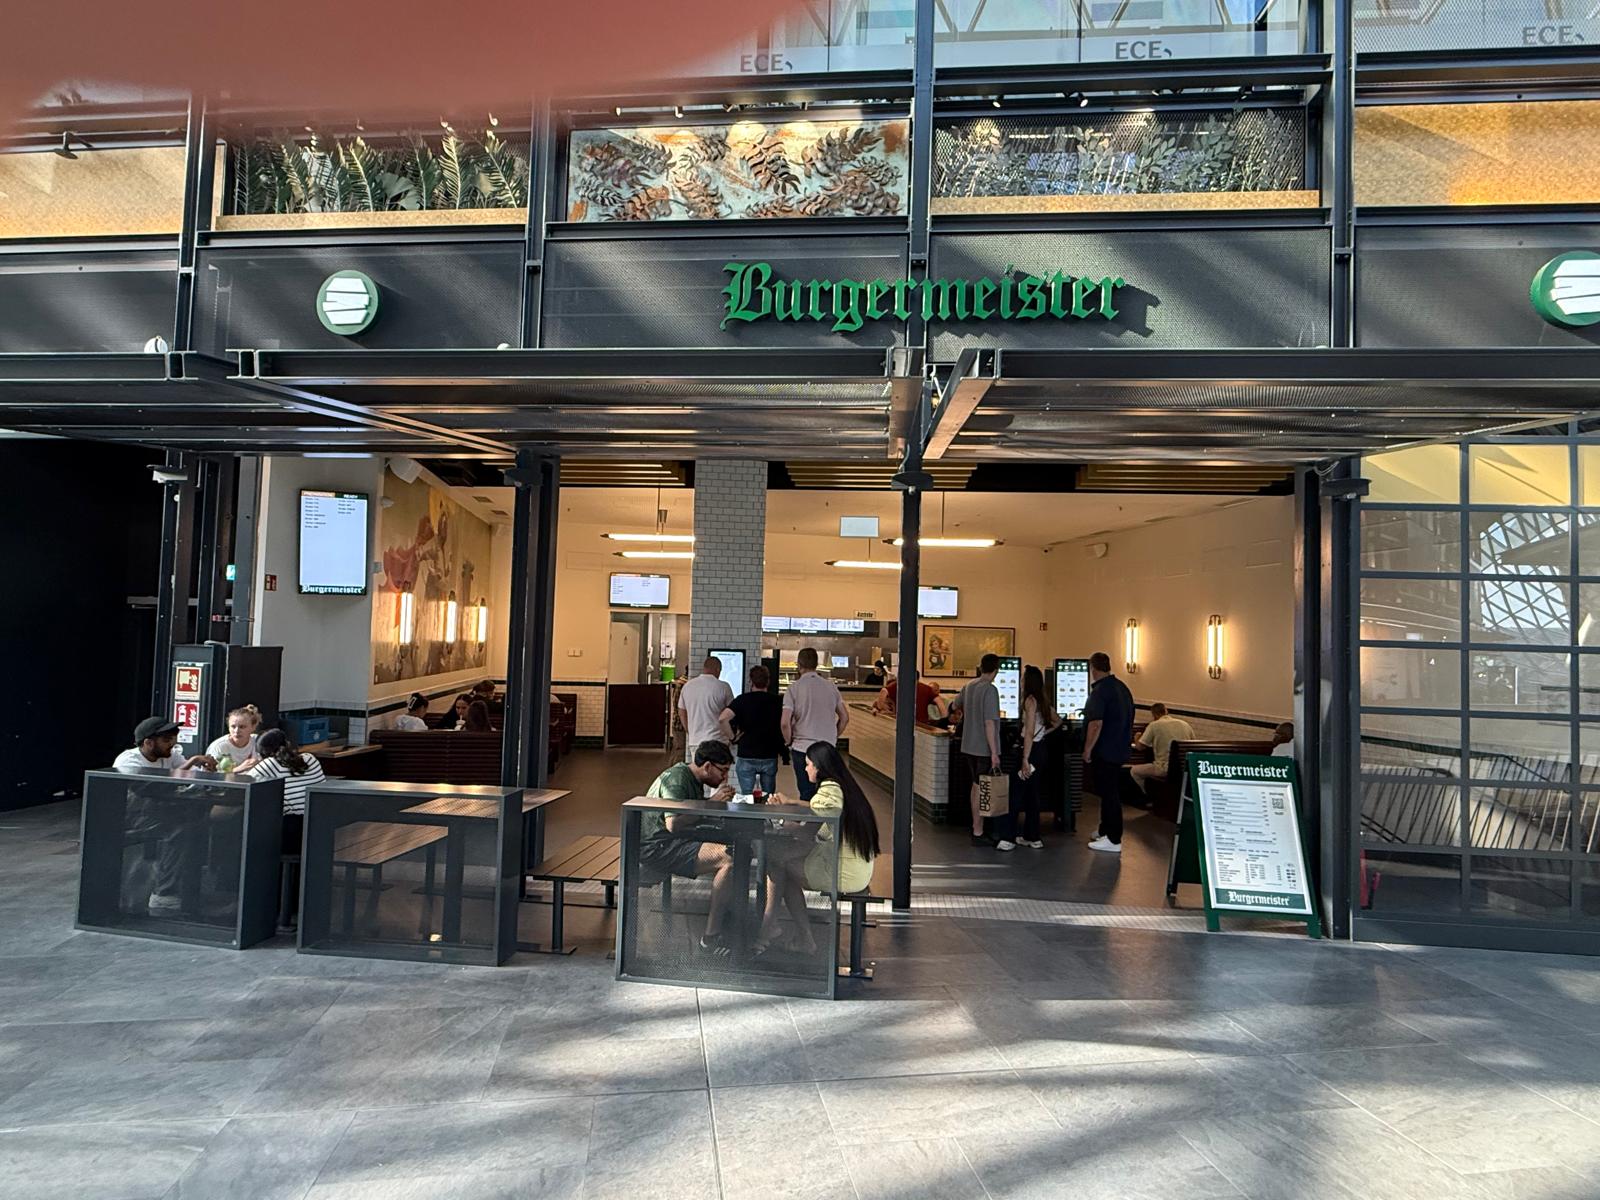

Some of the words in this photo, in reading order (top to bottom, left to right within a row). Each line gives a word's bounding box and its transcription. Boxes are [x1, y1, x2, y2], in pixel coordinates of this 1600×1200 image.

[720, 262, 1126, 332] Burgermeister
[1197, 760, 1290, 779] Burgermeister
[1228, 891, 1290, 906] Burgermeister
